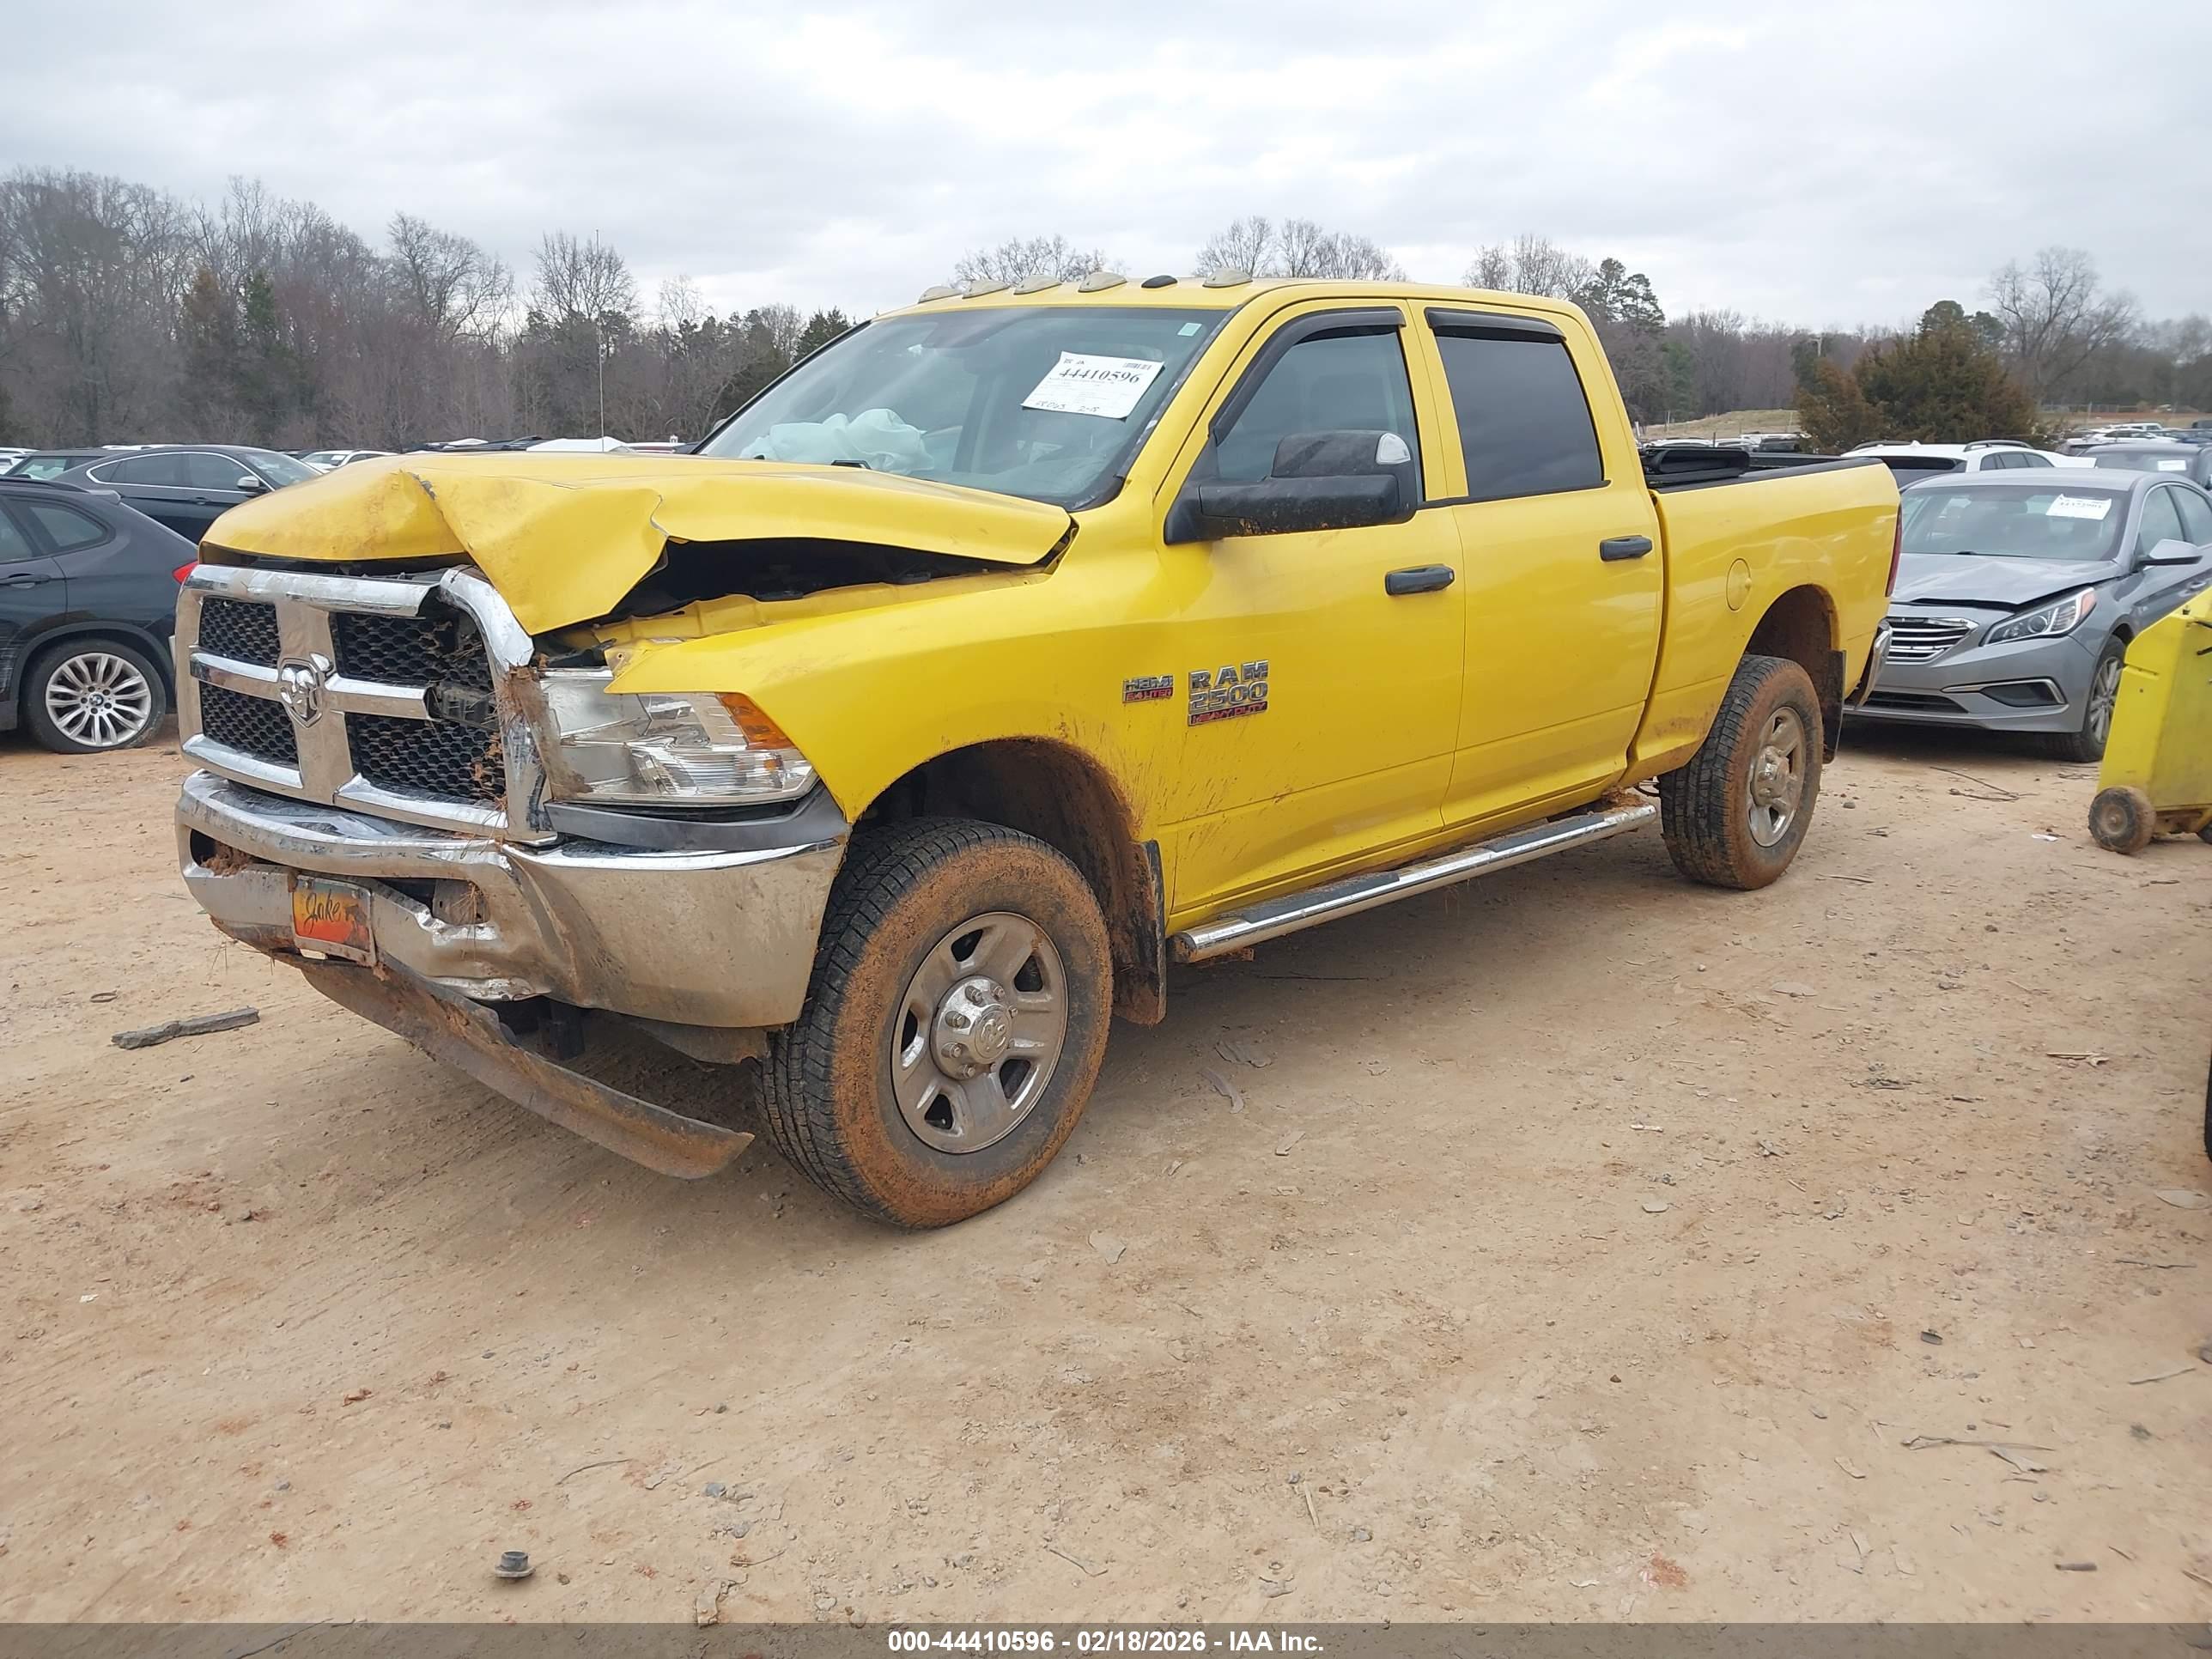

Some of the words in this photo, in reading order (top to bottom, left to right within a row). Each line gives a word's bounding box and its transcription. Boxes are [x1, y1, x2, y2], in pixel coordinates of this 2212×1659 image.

[1060, 368, 1143, 384] 44410596
[1125, 676, 1173, 690] HEMI
[1188, 659, 1268, 690] RAM
[1144, 689, 1172, 698] LITER
[1188, 681, 1268, 711] 2500
[1193, 708, 1232, 724] HEAVY
[1235, 702, 1266, 716] DUTY
